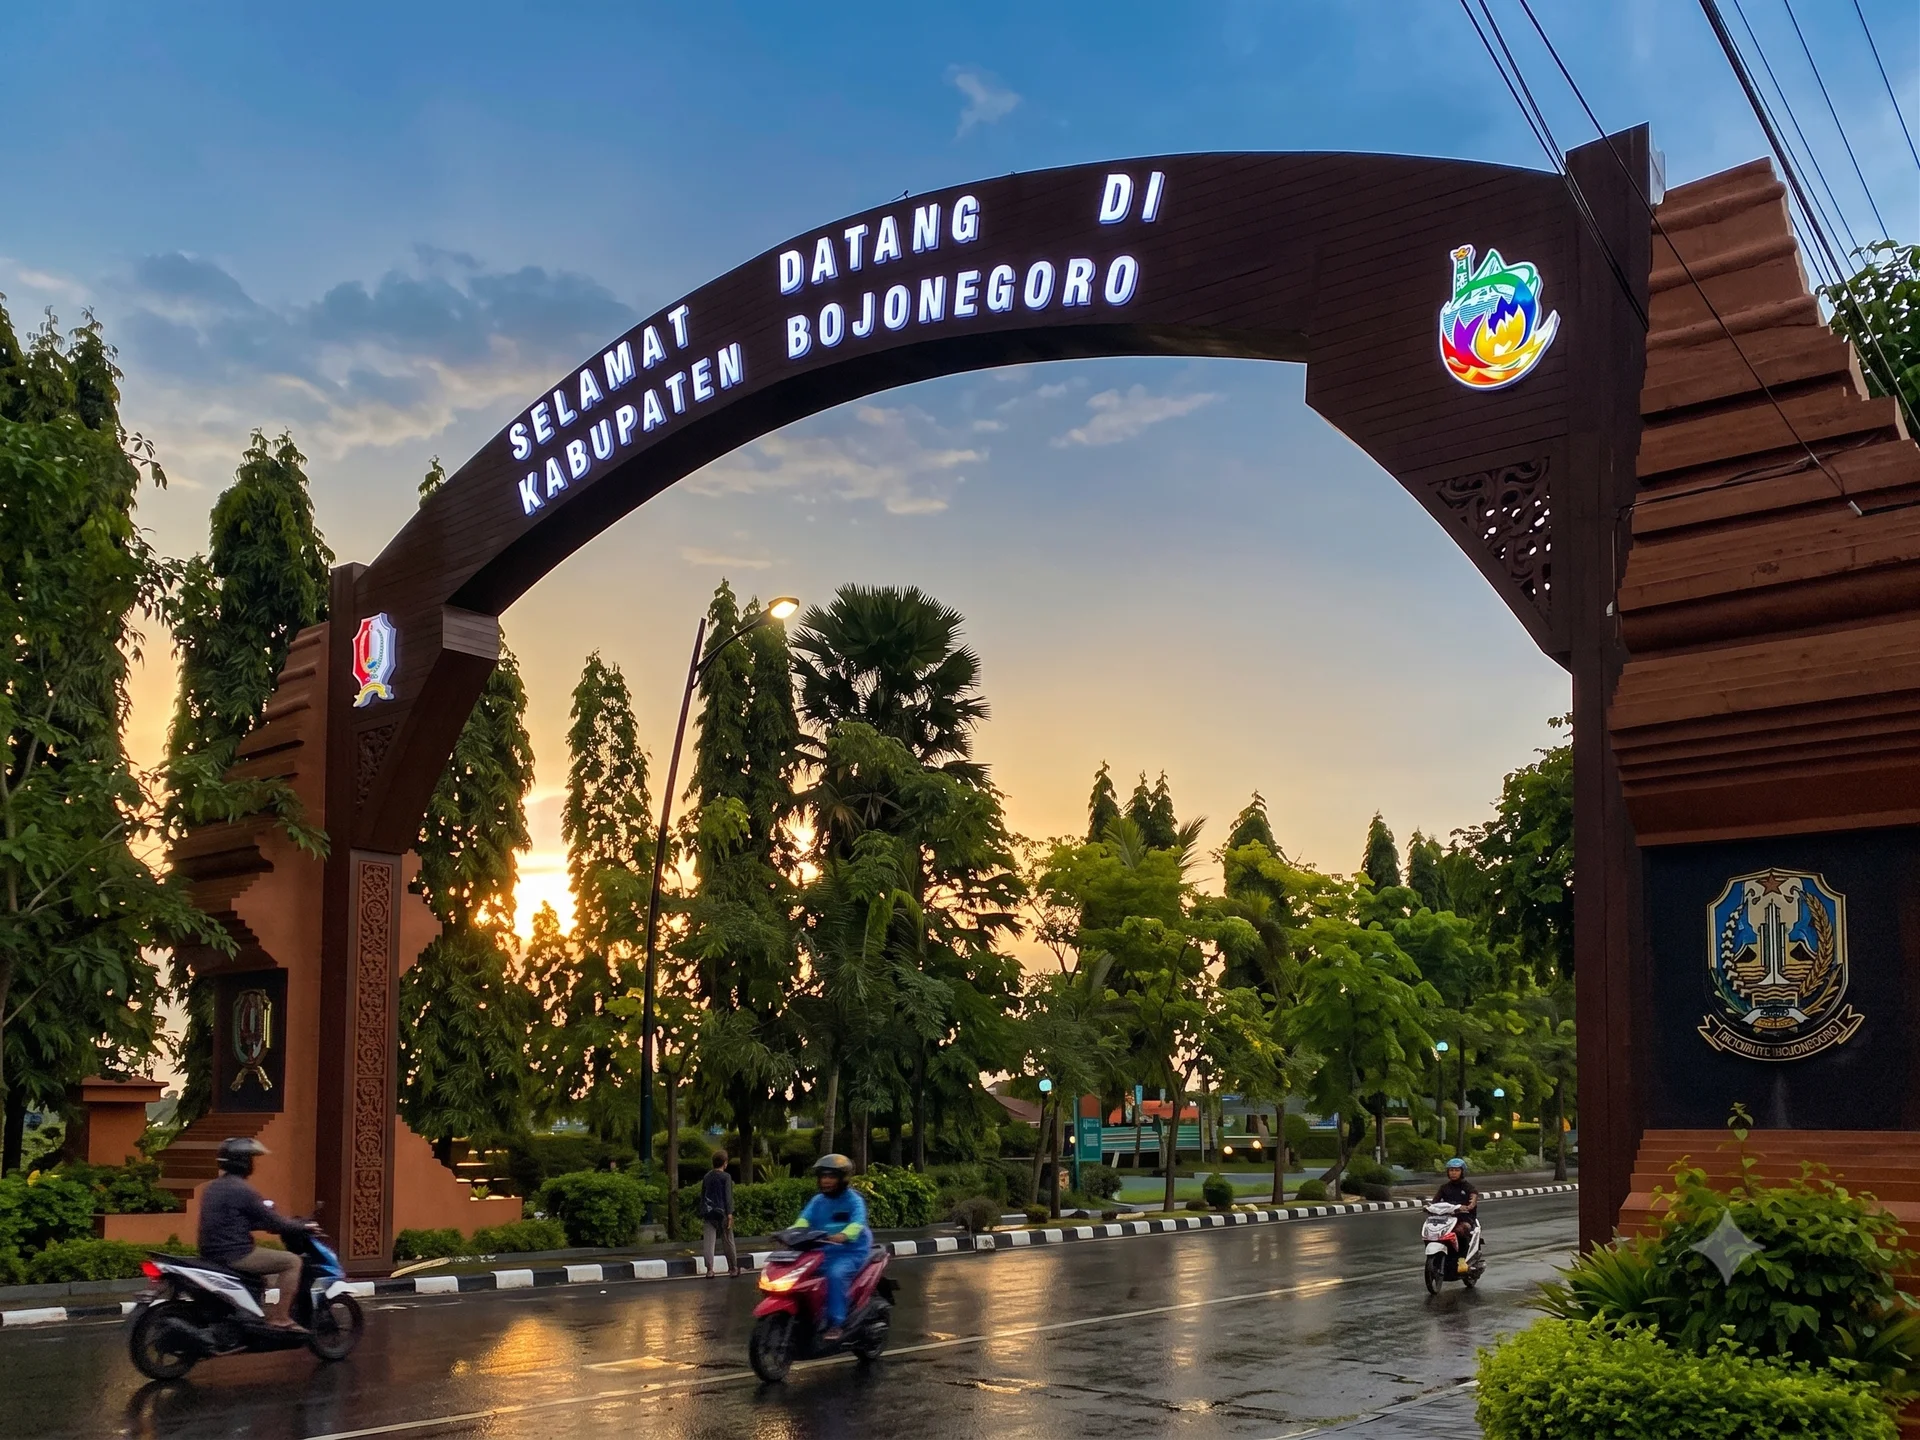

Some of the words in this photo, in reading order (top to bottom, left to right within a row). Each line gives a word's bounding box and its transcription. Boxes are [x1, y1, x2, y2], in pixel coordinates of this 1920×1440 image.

[508, 303, 690, 461] SELAMAT
[779, 194, 980, 294] DATANG
[1099, 170, 1165, 223] DI
[517, 341, 743, 516] KABUPATEN
[786, 254, 1138, 360] BOJONEGORO
